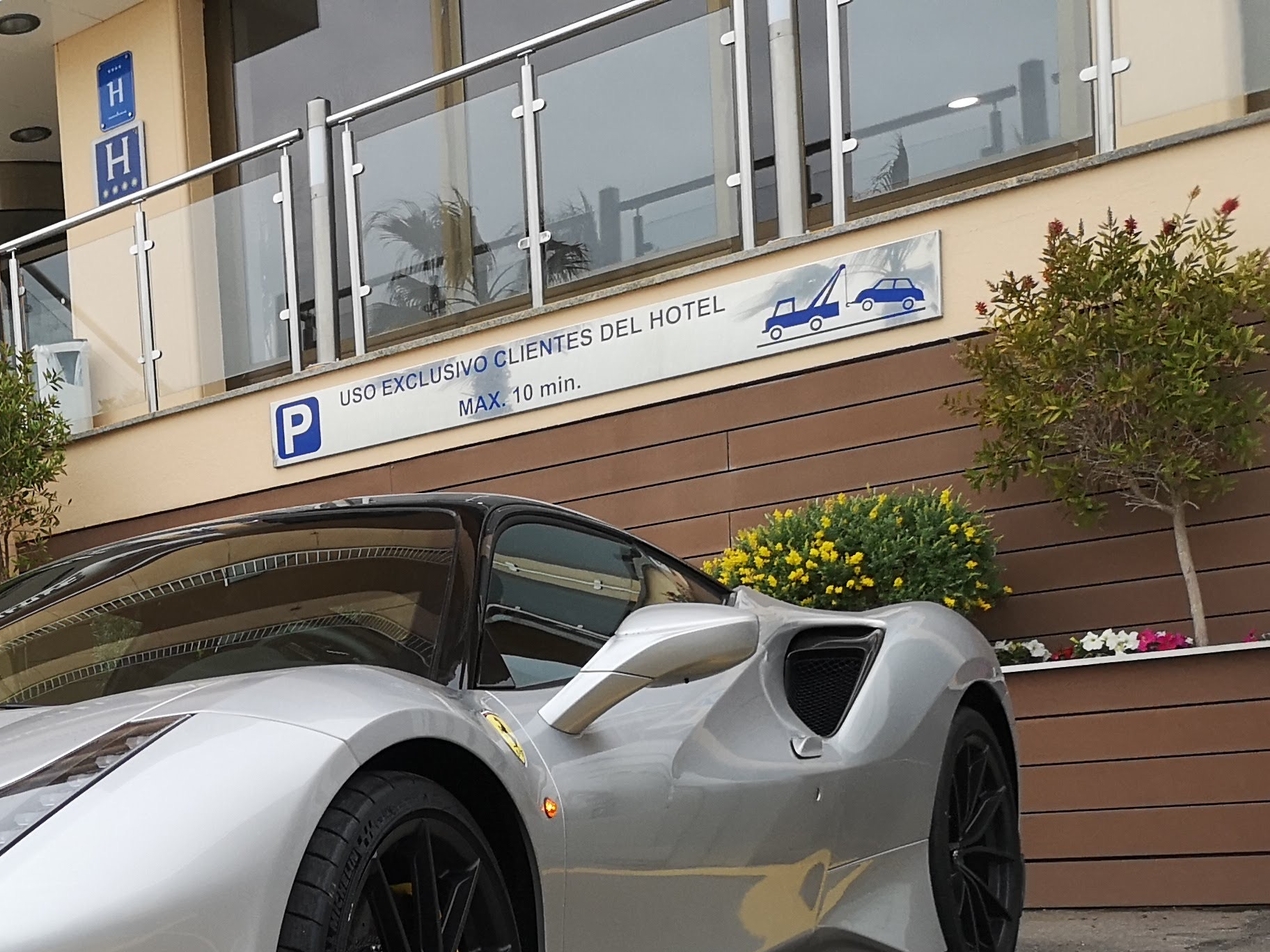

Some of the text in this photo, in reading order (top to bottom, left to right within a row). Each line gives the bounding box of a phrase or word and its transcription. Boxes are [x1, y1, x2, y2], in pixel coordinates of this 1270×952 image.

[106, 77, 124, 107] H
[105, 136, 131, 182] H
[340, 295, 726, 407] USO EXCLUSIVO CLIENTES DEL HOTEL
[458, 375, 582, 417] MAX. 10 min.
[282, 403, 313, 455] P
